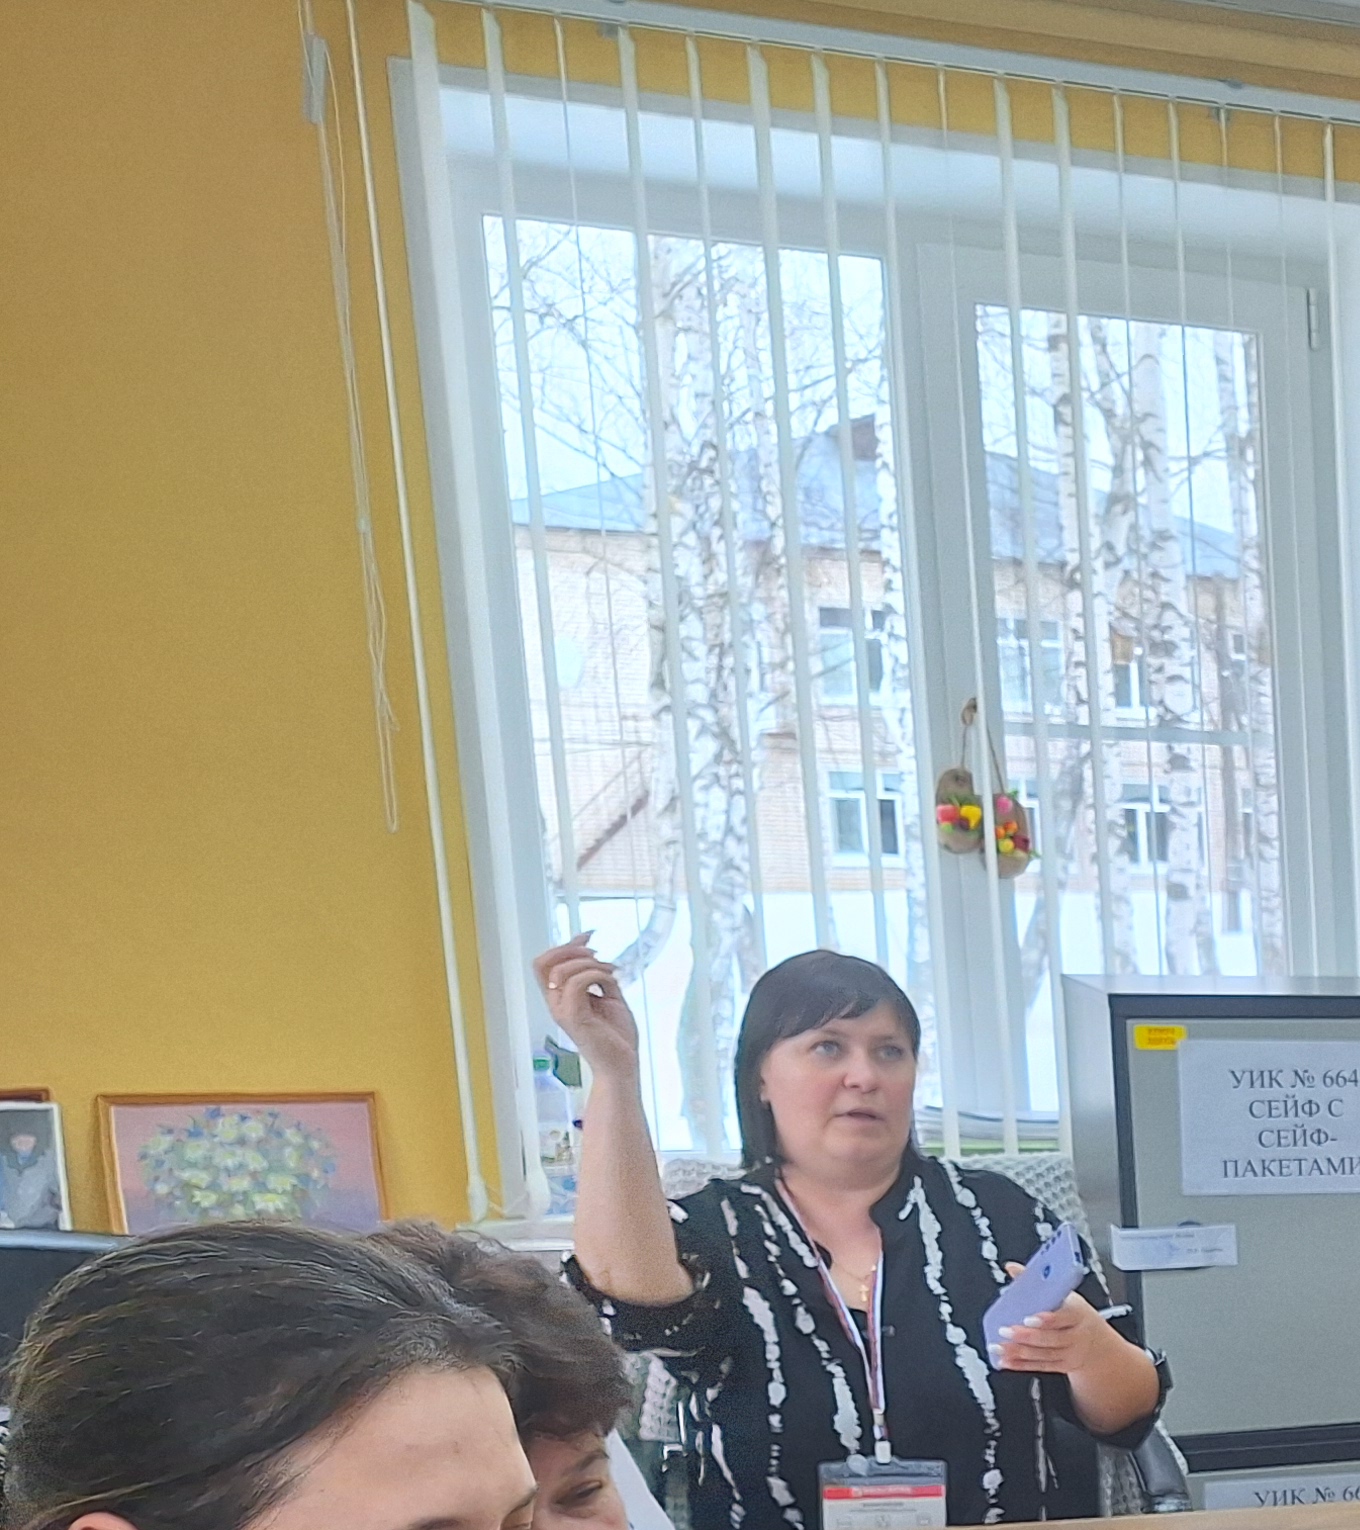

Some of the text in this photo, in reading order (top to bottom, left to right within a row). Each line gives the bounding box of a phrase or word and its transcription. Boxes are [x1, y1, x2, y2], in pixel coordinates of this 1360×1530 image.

[1229, 1068, 1359, 1089] УИК № 664
[1249, 1094, 1344, 1119] СЕЙФ С
[1258, 1123, 1338, 1149] СЕЙФ-
[1254, 1488, 1306, 1507] УИК
